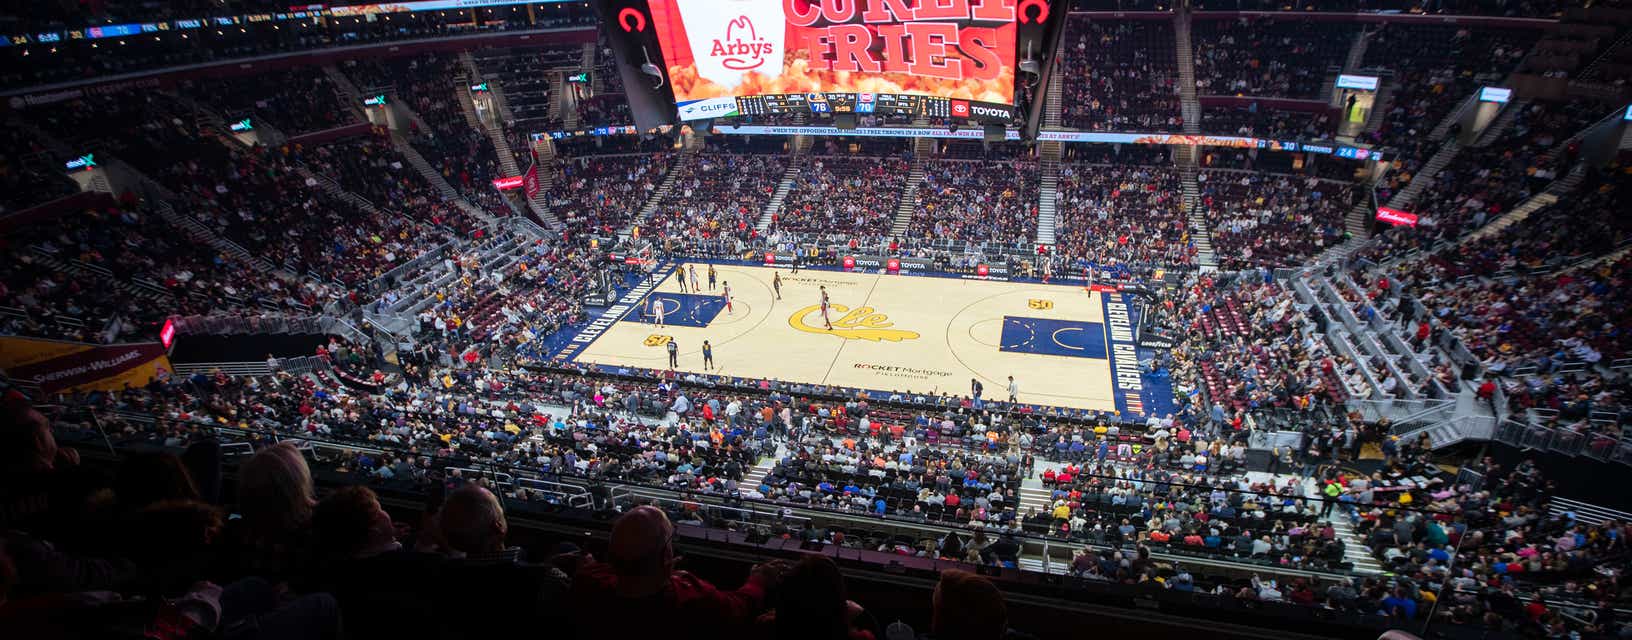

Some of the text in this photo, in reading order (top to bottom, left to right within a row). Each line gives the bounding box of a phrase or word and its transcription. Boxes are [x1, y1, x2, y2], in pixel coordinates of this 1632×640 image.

[710, 37, 773, 59] Arby's
[802, 22, 1001, 80] FRIES
[700, 103, 736, 113] CLIFFS
[813, 103, 826, 112] 76
[859, 103, 870, 112] 70
[972, 105, 1010, 118] TOYOTA
[1284, 142, 1295, 150] 30
[1302, 144, 1333, 154] REBOUNDS
[1028, 298, 1054, 310] 50
[33, 349, 143, 384] SHERWIN-WILLIAMS
[854, 363, 953, 378] ROCKET Mortgage
[1113, 343, 1143, 391] CAVALIERS
